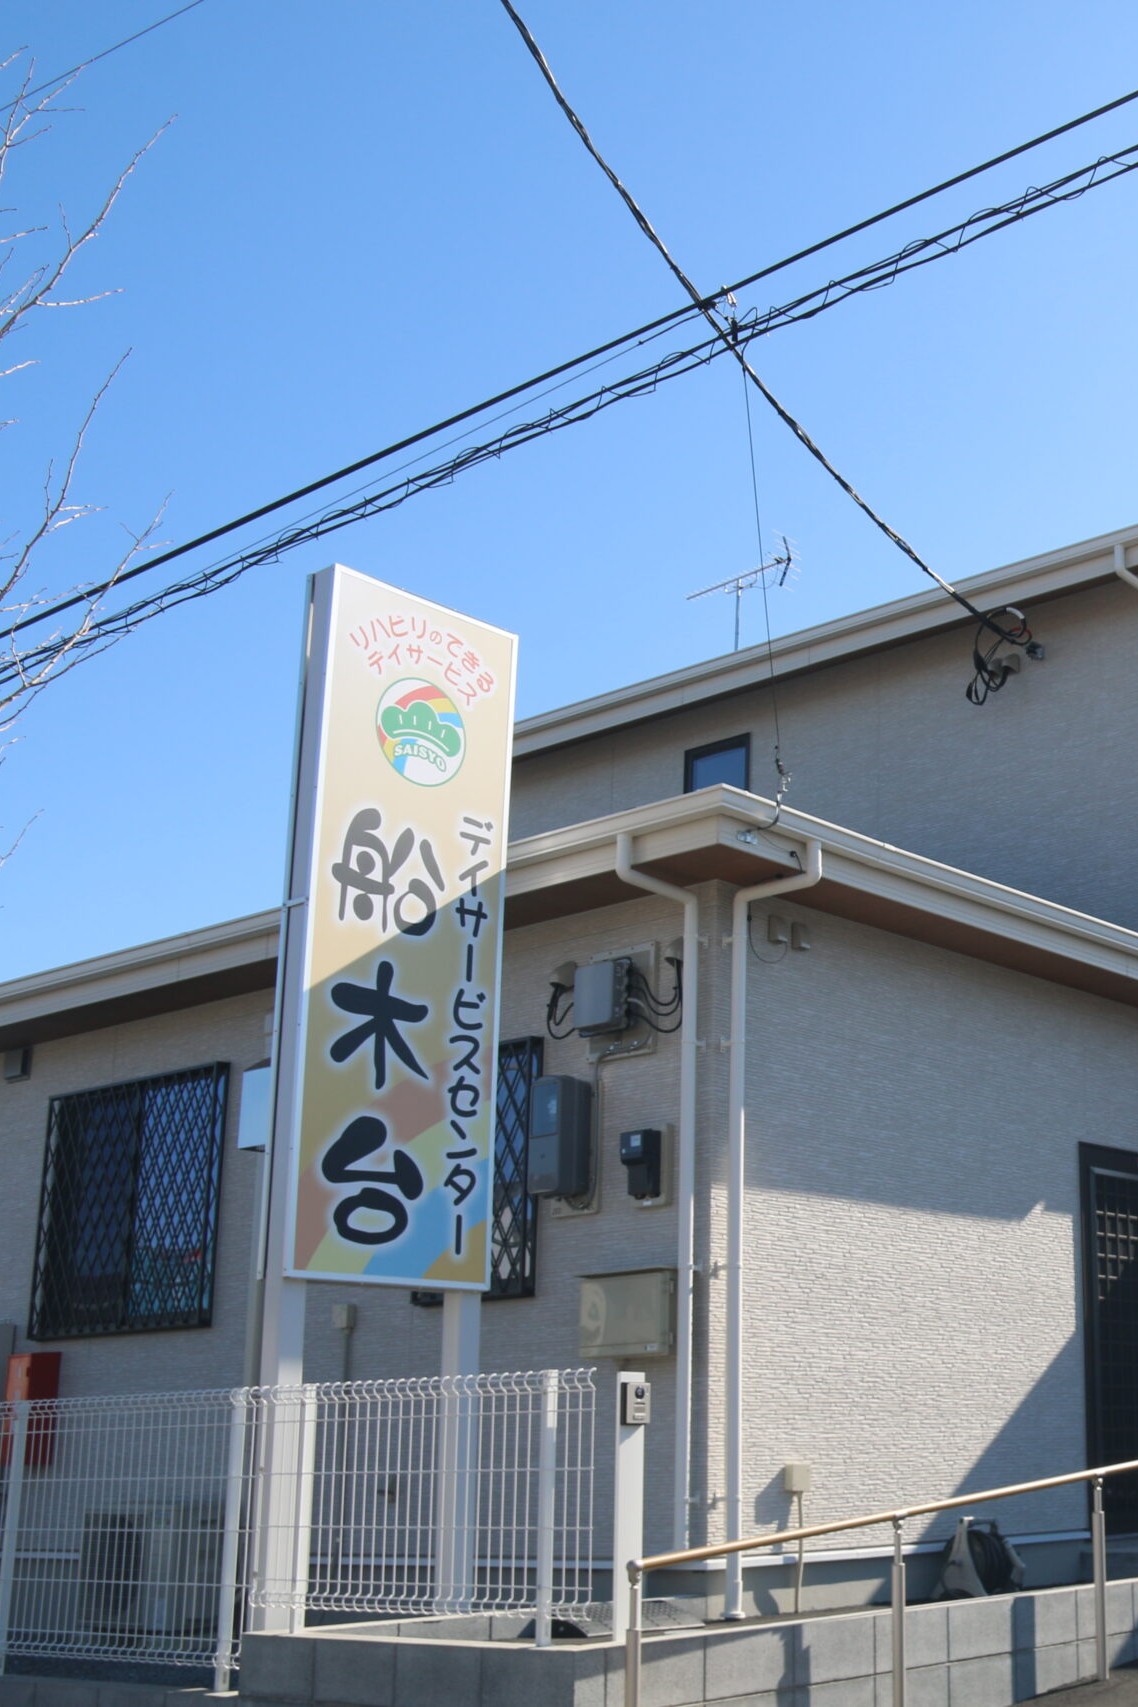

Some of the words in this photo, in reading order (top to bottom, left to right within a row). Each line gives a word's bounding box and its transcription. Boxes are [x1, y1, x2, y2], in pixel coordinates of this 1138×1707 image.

[349, 615, 494, 693] リハビリのできる
[367, 644, 477, 706] デイサービス
[393, 743, 447, 772] SAISYO
[321, 807, 445, 1245] 船木台
[443, 816, 493, 1256] デイサービスセンター
